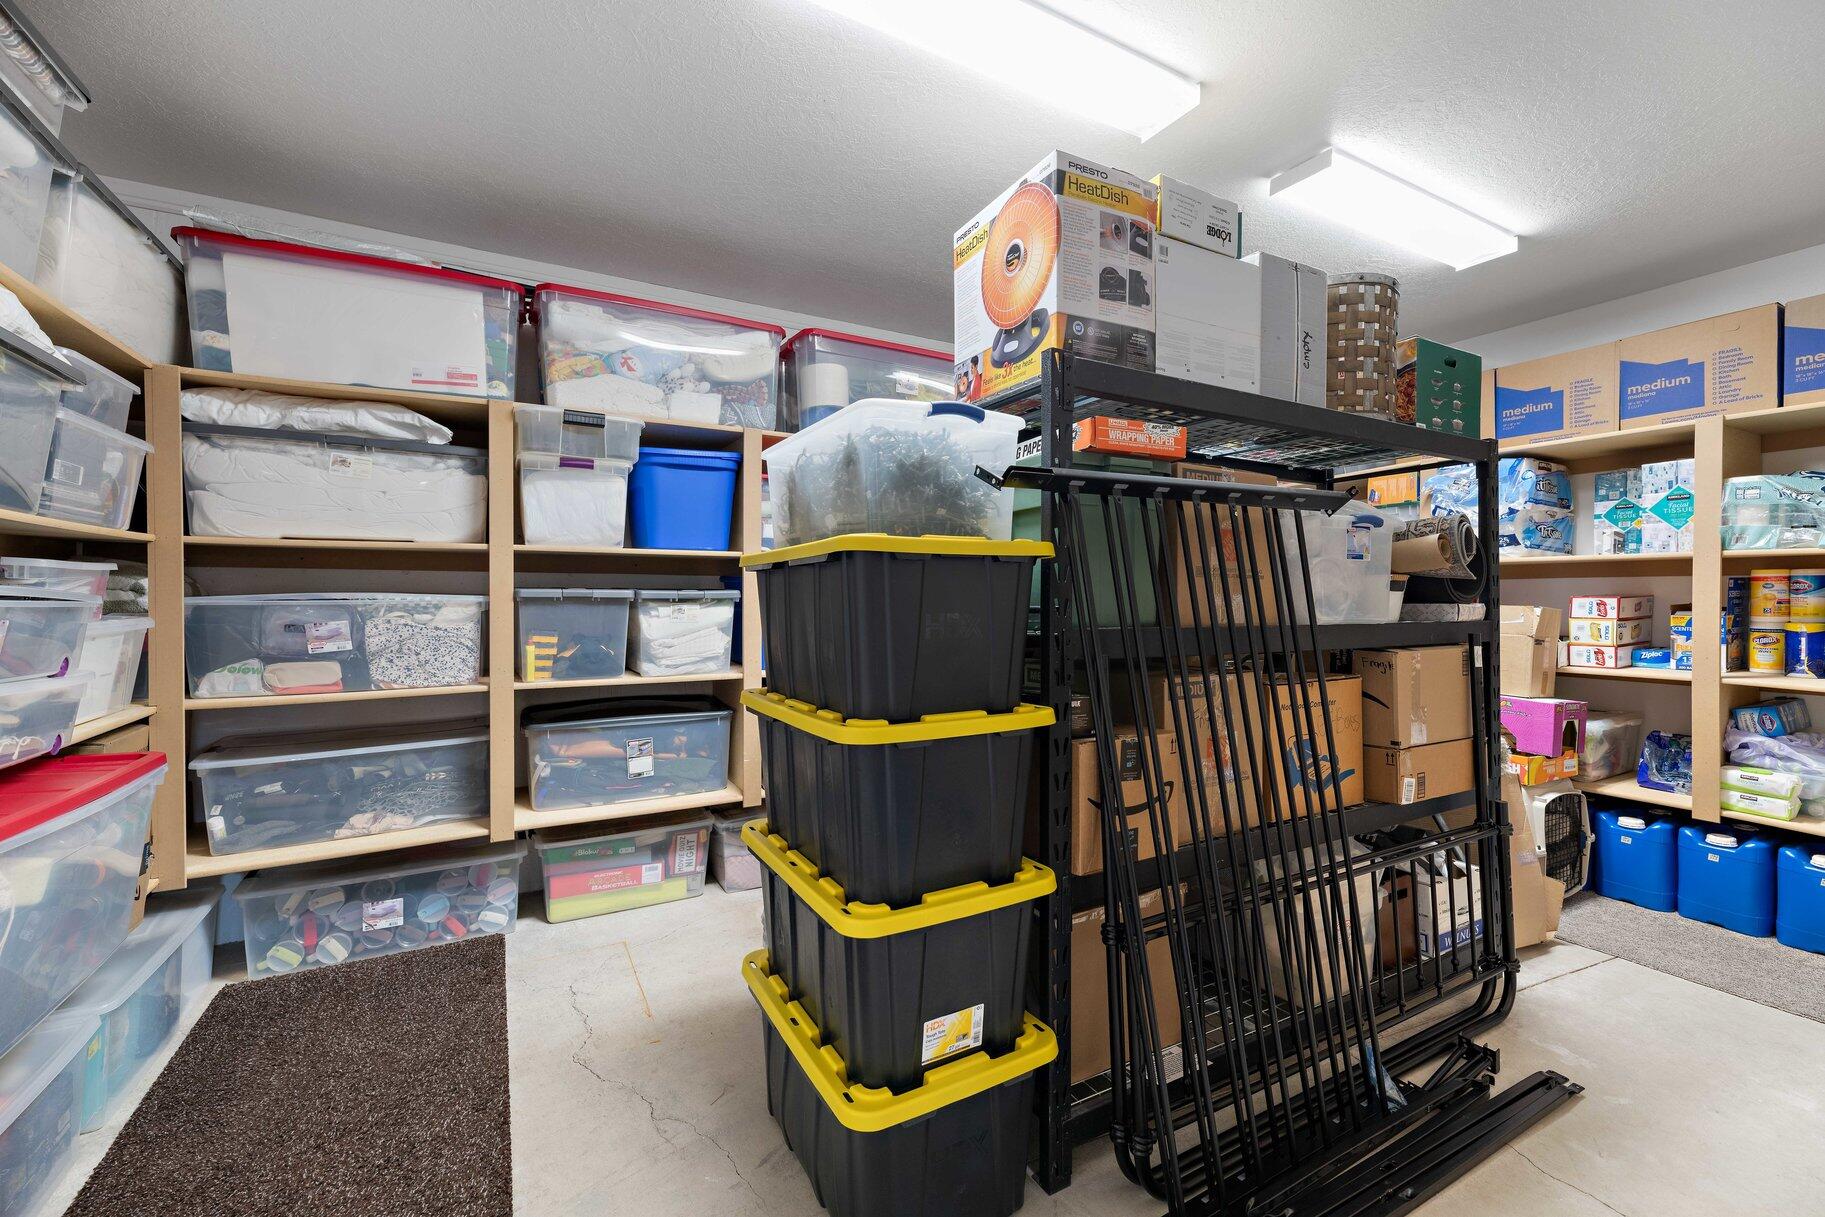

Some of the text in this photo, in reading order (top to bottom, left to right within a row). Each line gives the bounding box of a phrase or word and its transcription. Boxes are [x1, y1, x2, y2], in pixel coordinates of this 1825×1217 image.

[1068, 161, 1109, 180] PRESTO
[1068, 175, 1129, 206] HeatDish
[957, 221, 980, 244] PRESTO
[1206, 225, 1232, 247] LODGE
[956, 229, 989, 262] HeatDish
[1302, 330, 1313, 370] empty
[1627, 374, 1691, 395] medium
[1627, 390, 1657, 401] mediano
[1502, 401, 1553, 418] medium
[1108, 429, 1150, 444] WRAPPING
[1150, 432, 1175, 447] PAPER
[1022, 439, 1042, 458] PAPE
[1185, 471, 1222, 482] MEDIU
[1641, 650, 1663, 659] Ziploc
[678, 835, 687, 852] QUIZ
[686, 838, 696, 868] NIGHT
[591, 880, 639, 892] BASKETBALL
[1444, 925, 1480, 947] WLNUS
[926, 1019, 946, 1034] HDX
